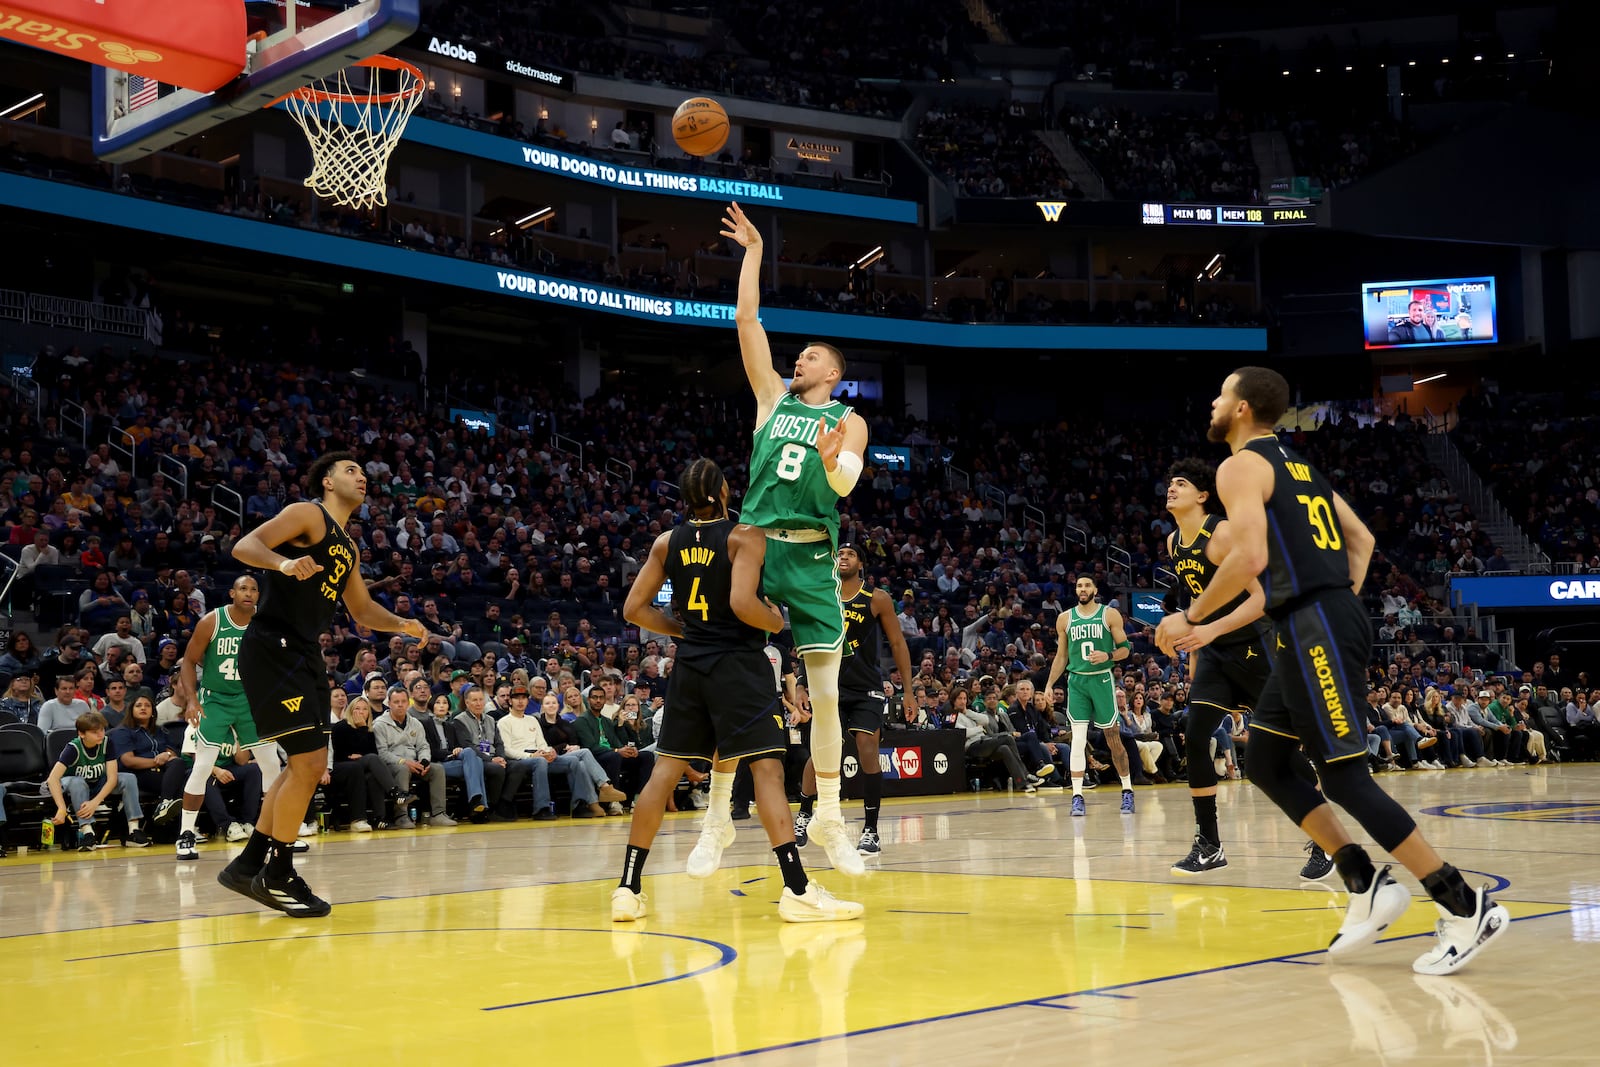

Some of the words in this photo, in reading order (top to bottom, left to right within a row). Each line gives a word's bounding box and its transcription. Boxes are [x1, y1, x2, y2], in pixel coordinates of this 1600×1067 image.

[0, 12, 96, 49] Stat
[428, 37, 477, 63] Adobe
[506, 60, 562, 84] ticketmaster
[522, 147, 559, 169] YOUR
[561, 157, 598, 179] DOOR
[599, 166, 616, 182] TO
[618, 170, 643, 186] ALL
[644, 172, 697, 192] THINGS
[699, 177, 783, 200] BASKETBALL
[1173, 209, 1194, 219] MIN
[1196, 208, 1212, 220] 106
[1223, 211, 1245, 220] MEM
[1247, 210, 1262, 222] 108
[1273, 211, 1307, 220] FINAL
[497, 271, 536, 293] YOUR
[538, 280, 578, 300] DOOR
[580, 288, 598, 304] TO
[599, 292, 623, 309] ALL
[624, 295, 672, 316] THINGS
[674, 302, 762, 322] BASKETBL
[1446, 283, 1486, 293] verizon
[776, 443, 807, 480] 8
[1296, 494, 1341, 551] 30
[680, 547, 715, 567] MOODY
[320, 582, 338, 602] STA
[687, 577, 709, 621] 4
[1070, 623, 1103, 642] BOSTON
[1308, 645, 1351, 738] WARRIORS
